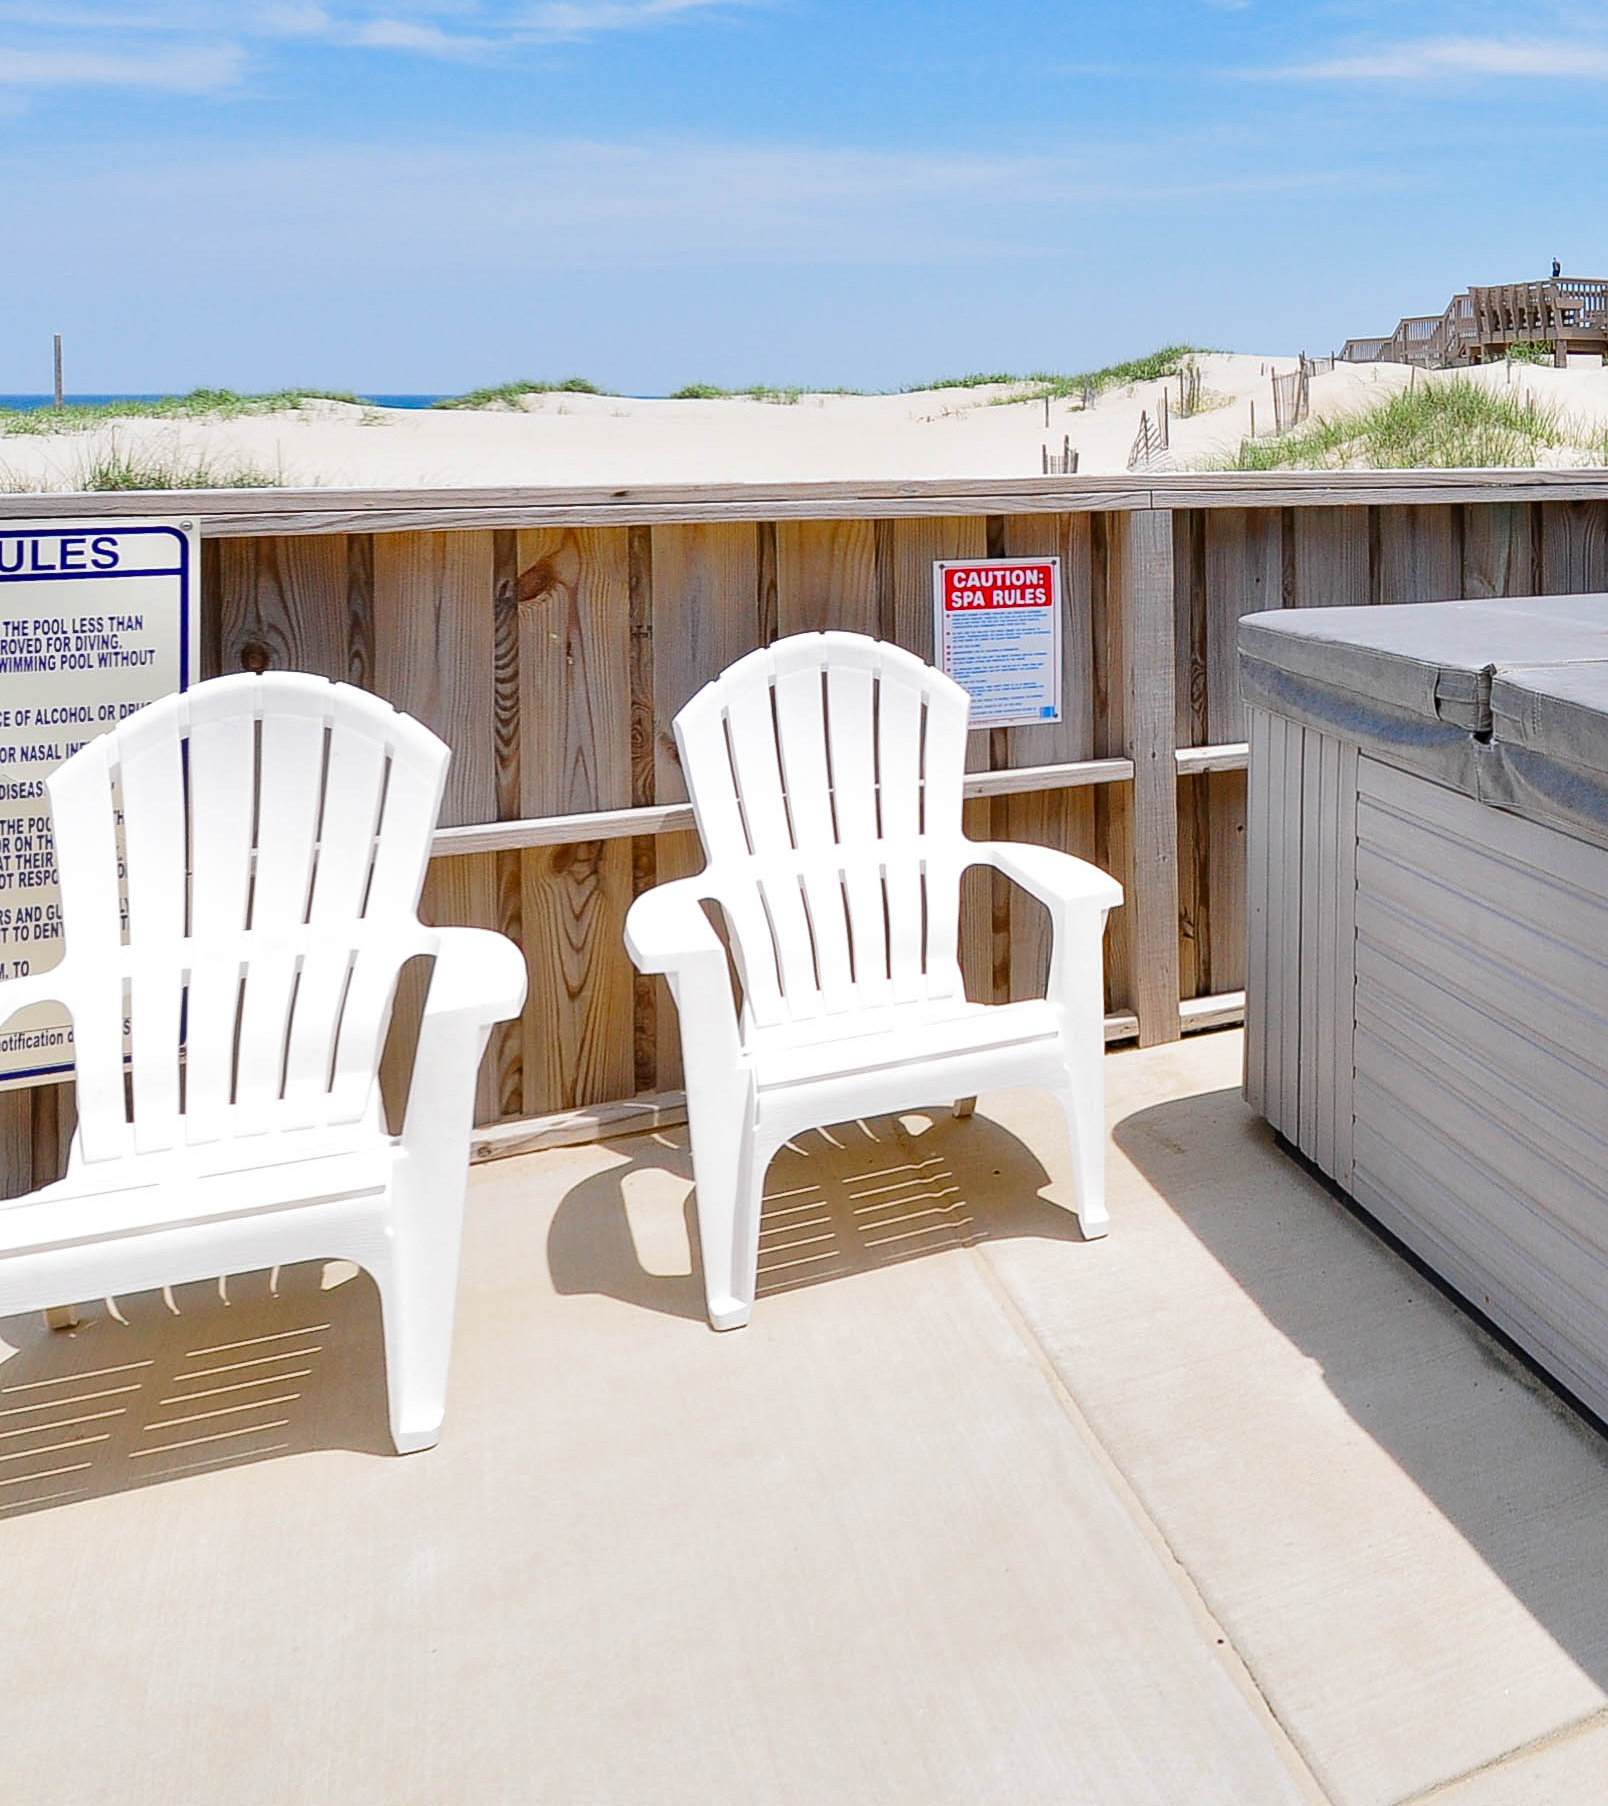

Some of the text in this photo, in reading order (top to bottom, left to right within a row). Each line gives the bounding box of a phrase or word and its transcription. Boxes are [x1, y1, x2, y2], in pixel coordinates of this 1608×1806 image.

[0, 536, 119, 572] ULES
[953, 569, 1044, 588] CAUTION:
[951, 588, 1046, 608] SPA RULES
[3, 615, 143, 637] THE POOL LESS THAN
[0, 634, 123, 655] ROVED FOR DIVING.
[60, 653, 94, 670] POOL
[98, 649, 156, 668] WITHOUT
[15, 709, 31, 726] OF
[35, 706, 94, 725] ALCOHOL
[98, 704, 115, 721] OR
[0, 747, 16, 763] OR
[20, 744, 62, 762] NASAL
[0, 781, 46, 800] DISEAS
[0, 818, 24, 835] THE
[15, 836, 32, 852] ON
[15, 852, 53, 870] THEIR
[16, 906, 42, 924] AND
[13, 925, 29, 943] TO
[13, 961, 29, 978] TO
[0, 1030, 63, 1052] otification
